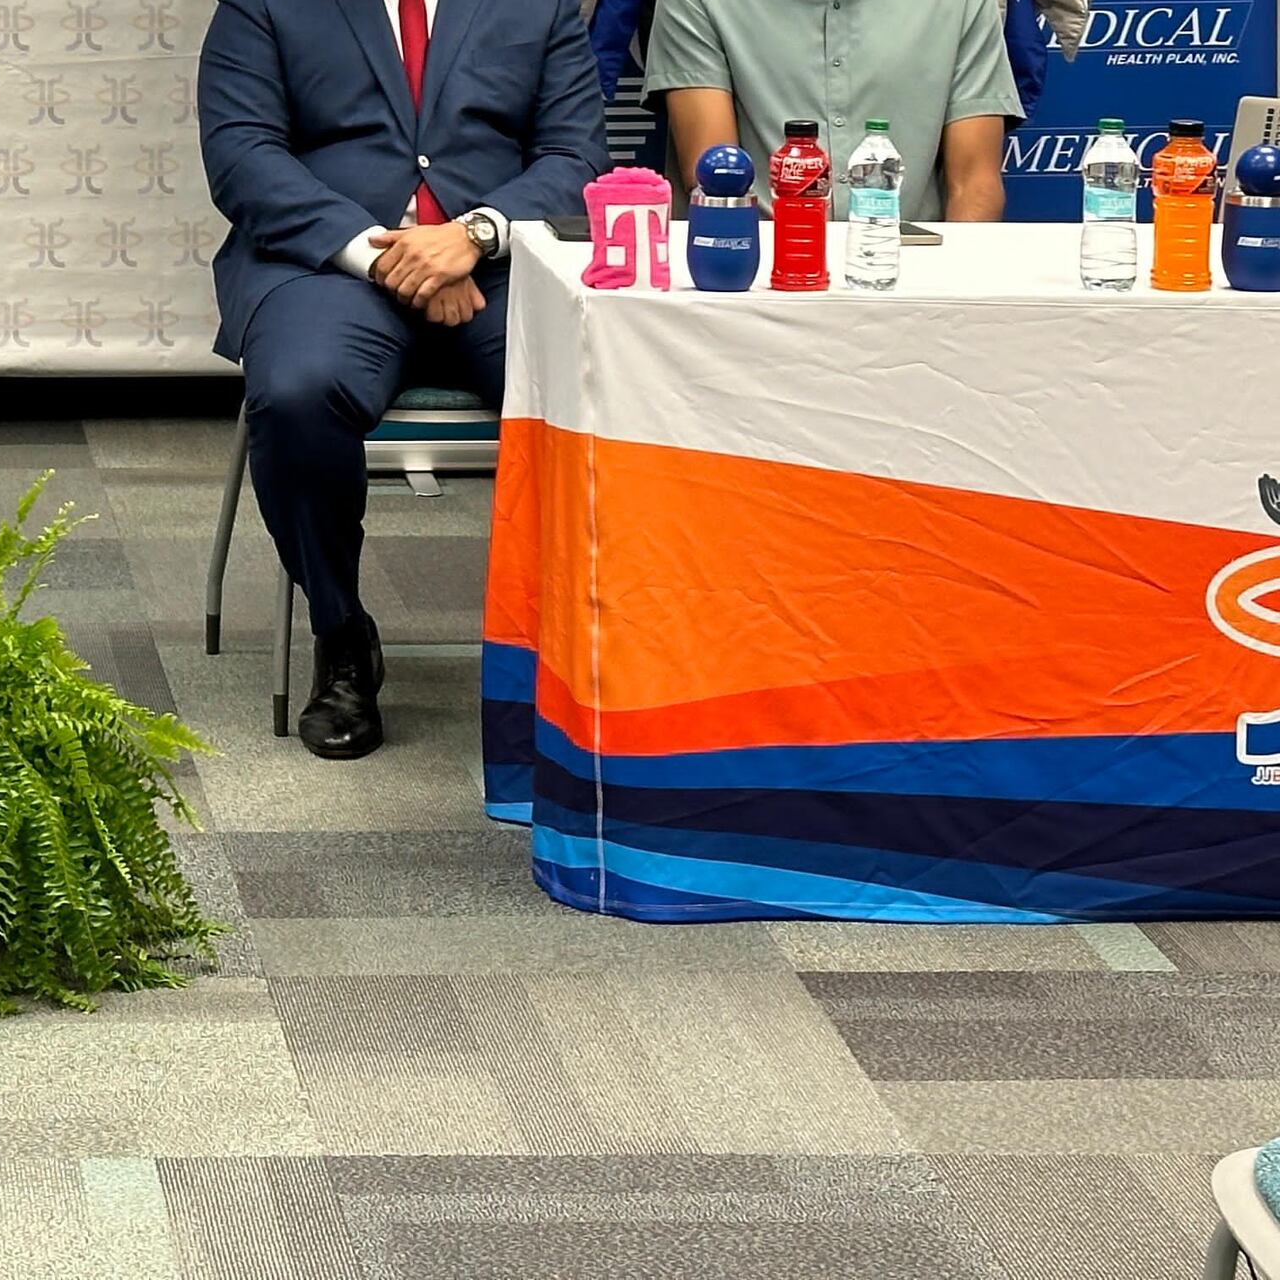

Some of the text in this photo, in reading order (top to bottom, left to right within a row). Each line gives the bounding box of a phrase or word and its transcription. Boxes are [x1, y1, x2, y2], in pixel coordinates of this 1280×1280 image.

[1106, 52, 1240, 65] HEALTH PLAN, INC.
